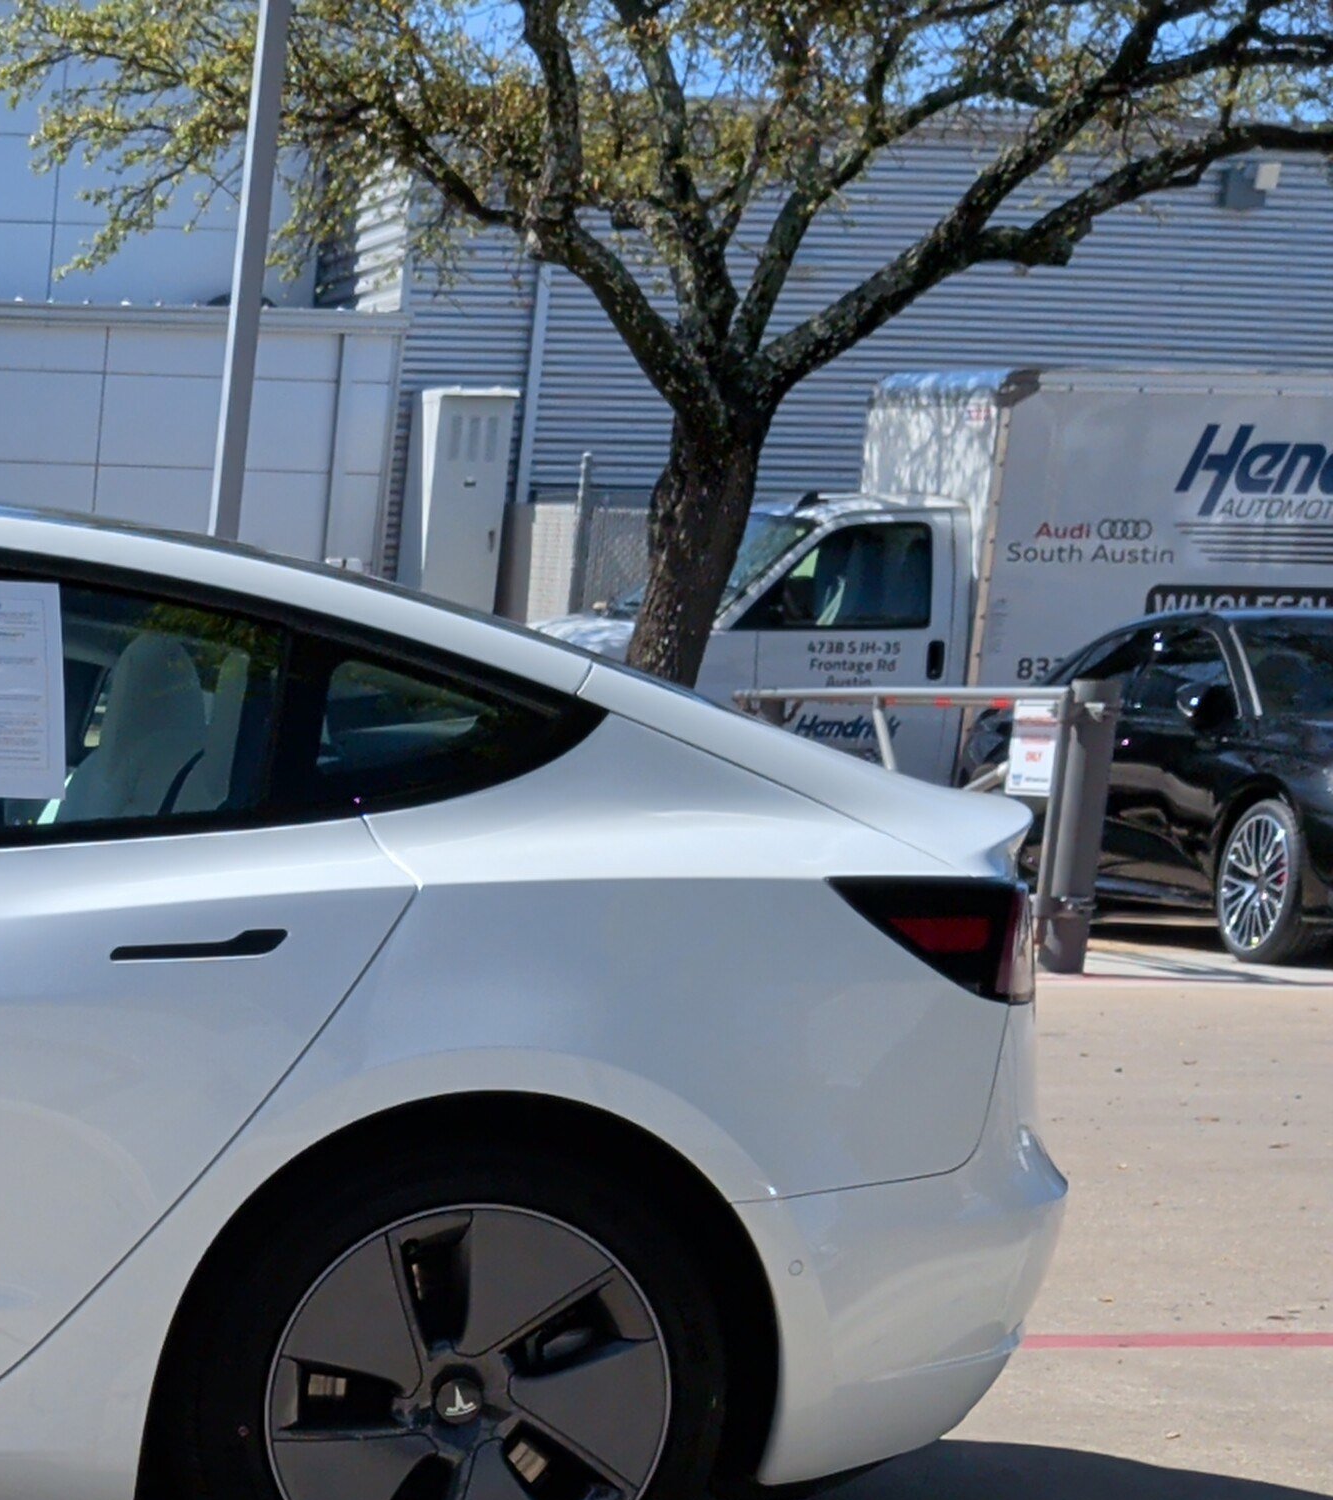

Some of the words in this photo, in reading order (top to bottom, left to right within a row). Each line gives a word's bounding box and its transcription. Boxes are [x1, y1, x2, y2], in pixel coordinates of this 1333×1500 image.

[1035, 522, 1091, 539] Audi
[1007, 542, 1083, 562] South
[1091, 544, 1174, 564] Austin
[807, 641, 845, 654] 4738
[847, 641, 856, 654] S
[809, 658, 873, 674] Frontage
[877, 659, 897, 672] Rd
[1017, 657, 1064, 680] 83
[826, 675, 872, 687] Austin
[794, 714, 901, 739] Hendrk
